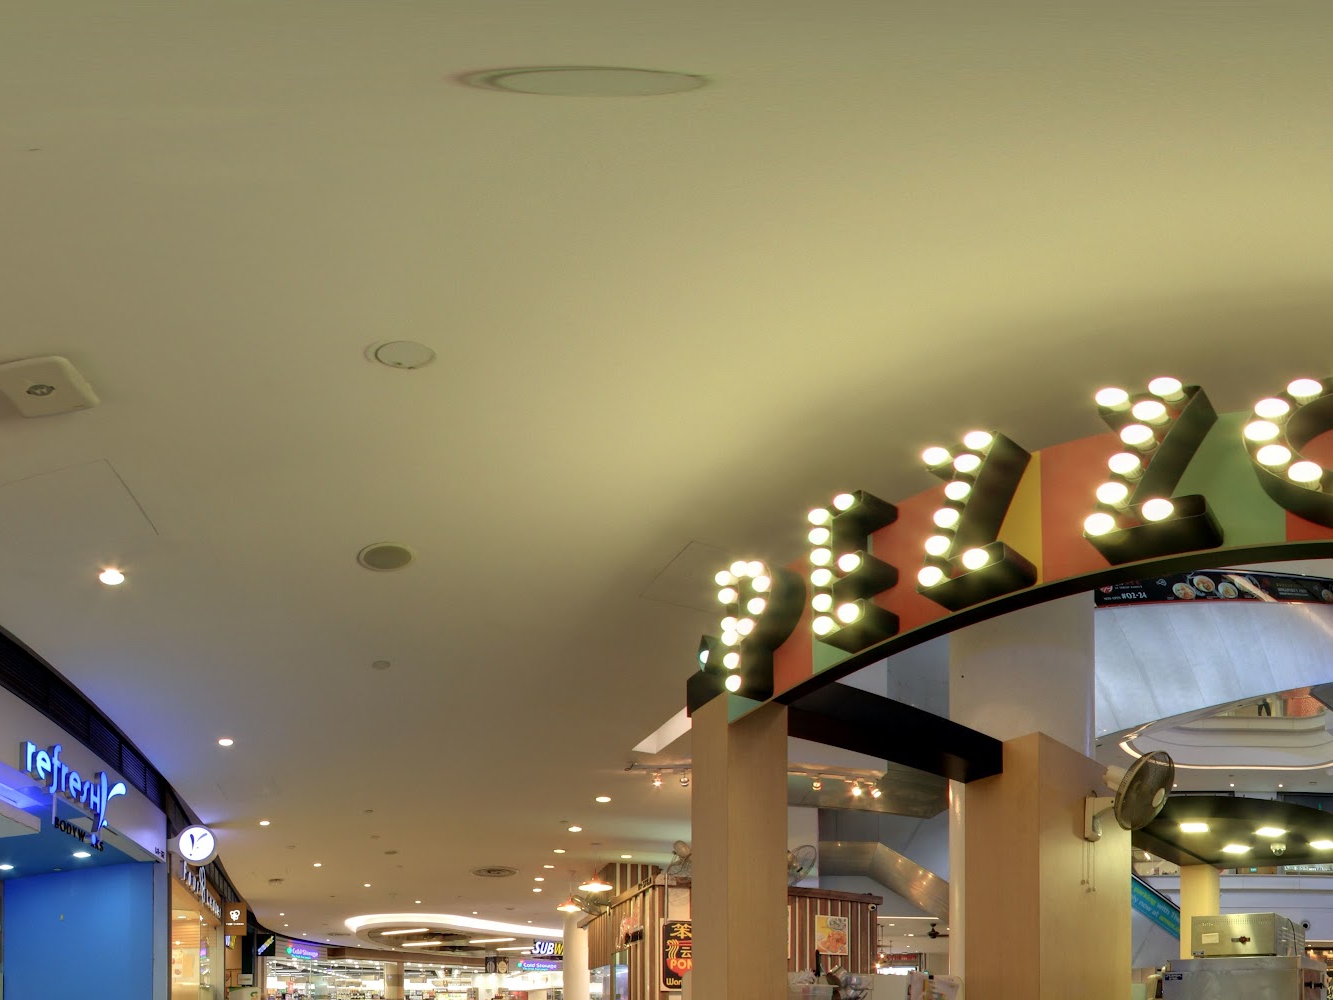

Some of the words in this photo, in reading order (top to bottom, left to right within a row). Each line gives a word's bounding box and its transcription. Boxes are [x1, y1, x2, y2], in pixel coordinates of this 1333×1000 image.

[1134, 887, 1156, 906] parking
[1157, 903, 1170, 915] with
[1139, 900, 1152, 911] now
[1152, 910, 1159, 918] at
[670, 923, 692, 939] 笨
[532, 941, 563, 955] SUBW
